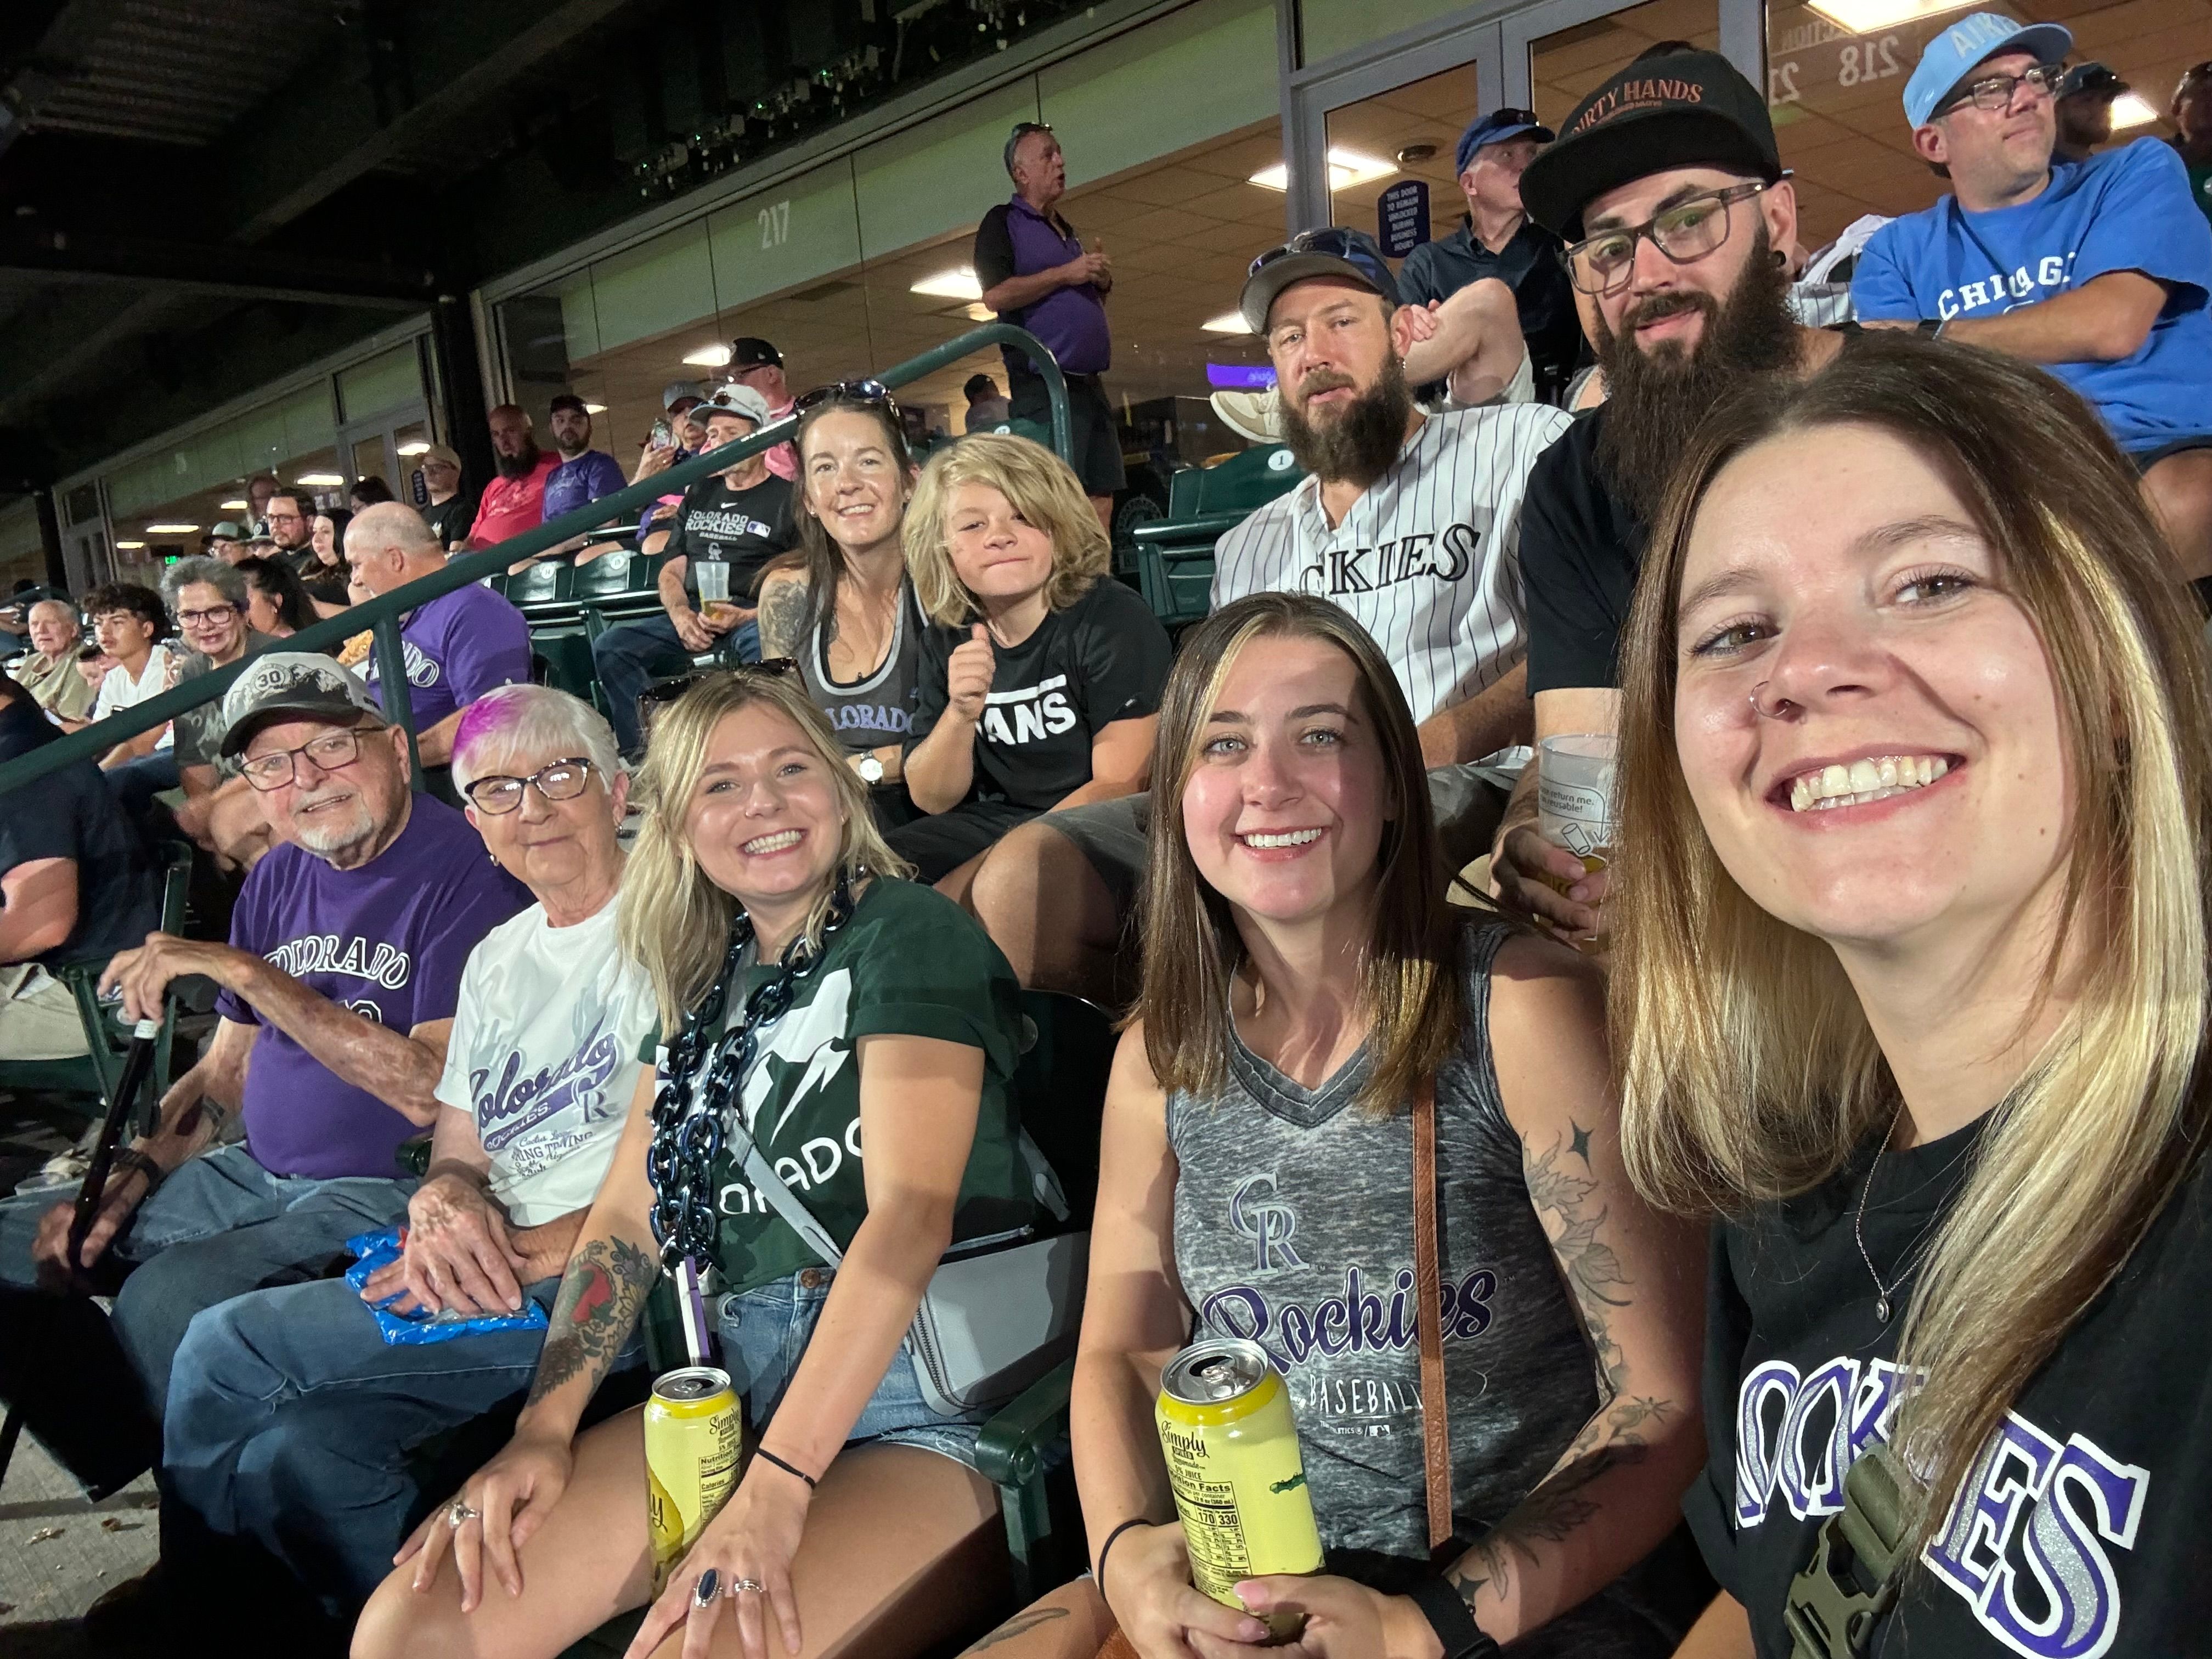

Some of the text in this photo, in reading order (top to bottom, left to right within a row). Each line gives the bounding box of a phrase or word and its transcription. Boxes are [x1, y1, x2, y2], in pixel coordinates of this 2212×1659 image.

[1624, 79, 1703, 103] HANDS
[758, 200, 789, 249] 217
[1938, 252, 2076, 321] CHICAG
[1278, 455, 1284, 465] 1
[685, 518, 747, 536] ROCKIES
[699, 532, 737, 541] BASEBALL
[258, 670, 281, 687] 30
[976, 692, 1076, 745] ANS
[1550, 791, 1575, 803] return
[1547, 799, 1583, 814] reusable!
[1229, 1171, 1310, 1277] CR
[1201, 1267, 1498, 1375] Rockies
[1161, 1420, 1210, 1459] Simply
[701, 1449, 733, 1464] Nutrition
[1185, 1469, 1203, 1481] JUICE
[702, 1478, 725, 1490] Calories
[1199, 1483, 1231, 1492] Facts
[1198, 1511, 1215, 1524] 170
[1218, 1514, 1238, 1525] 330
